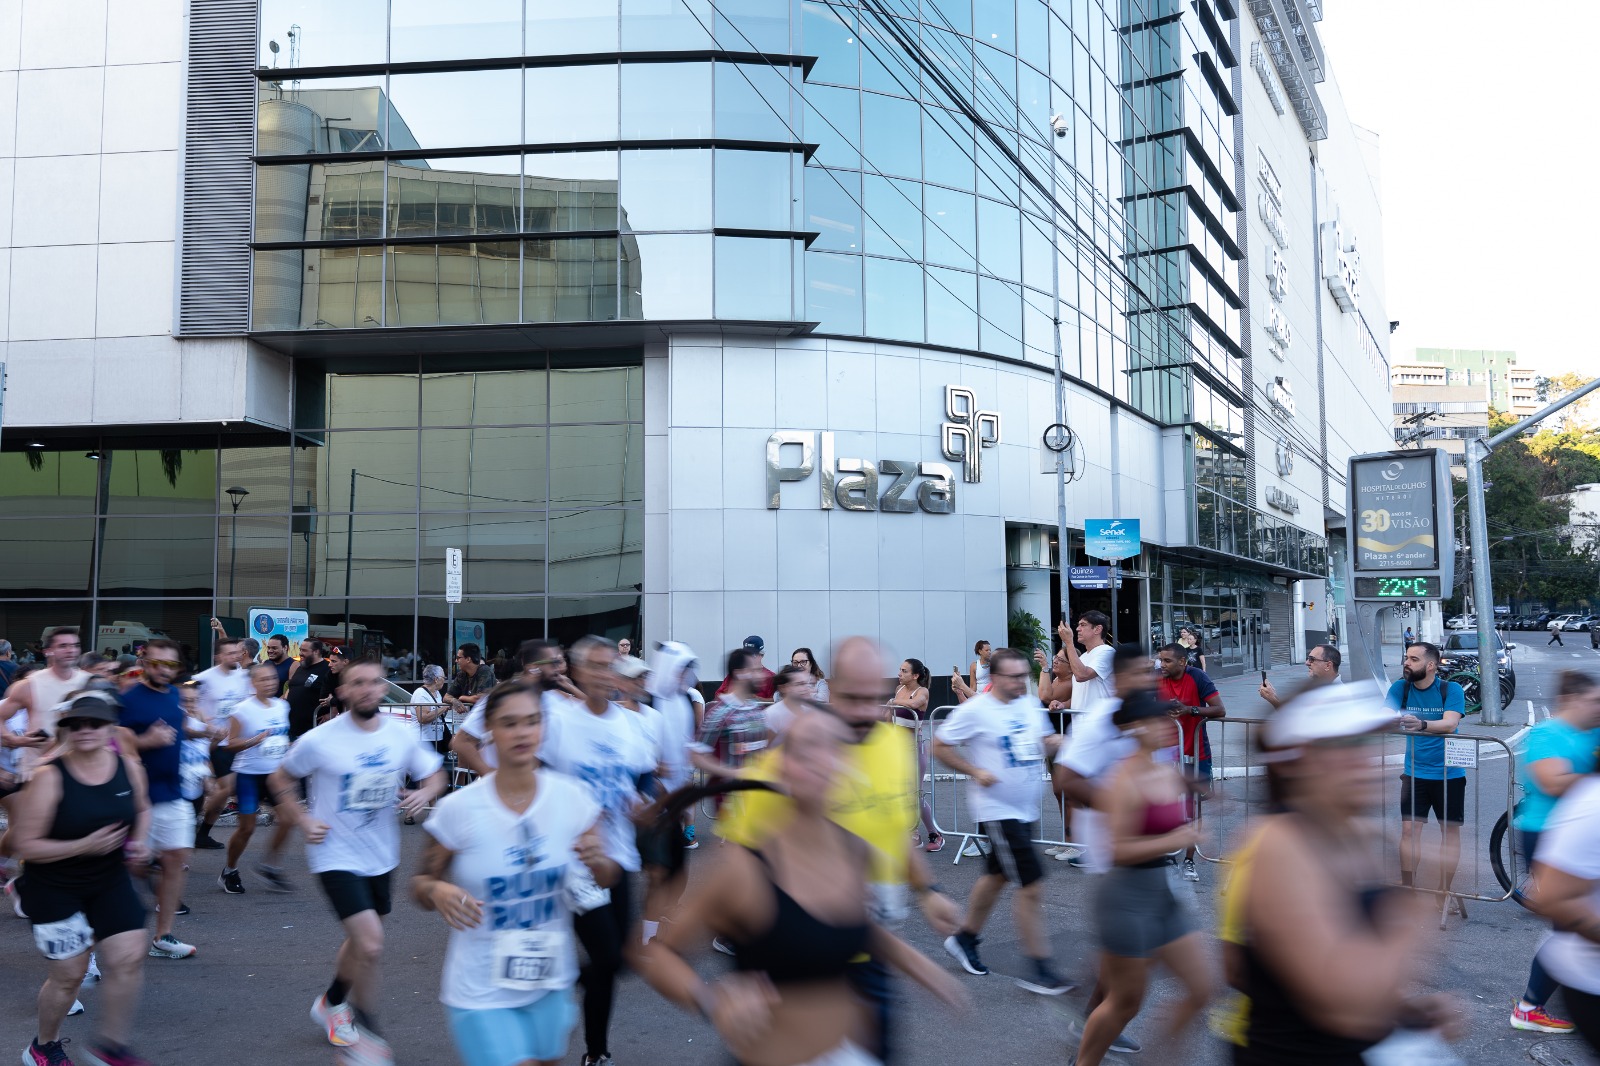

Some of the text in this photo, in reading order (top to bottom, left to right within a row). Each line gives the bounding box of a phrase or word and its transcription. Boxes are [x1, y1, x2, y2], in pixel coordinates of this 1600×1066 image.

[766, 431, 956, 514] Plaza
[1361, 484, 1394, 492] HOSPITAL
[1361, 508, 1391, 533] 30
[1391, 517, 1430, 529] VISÃO
